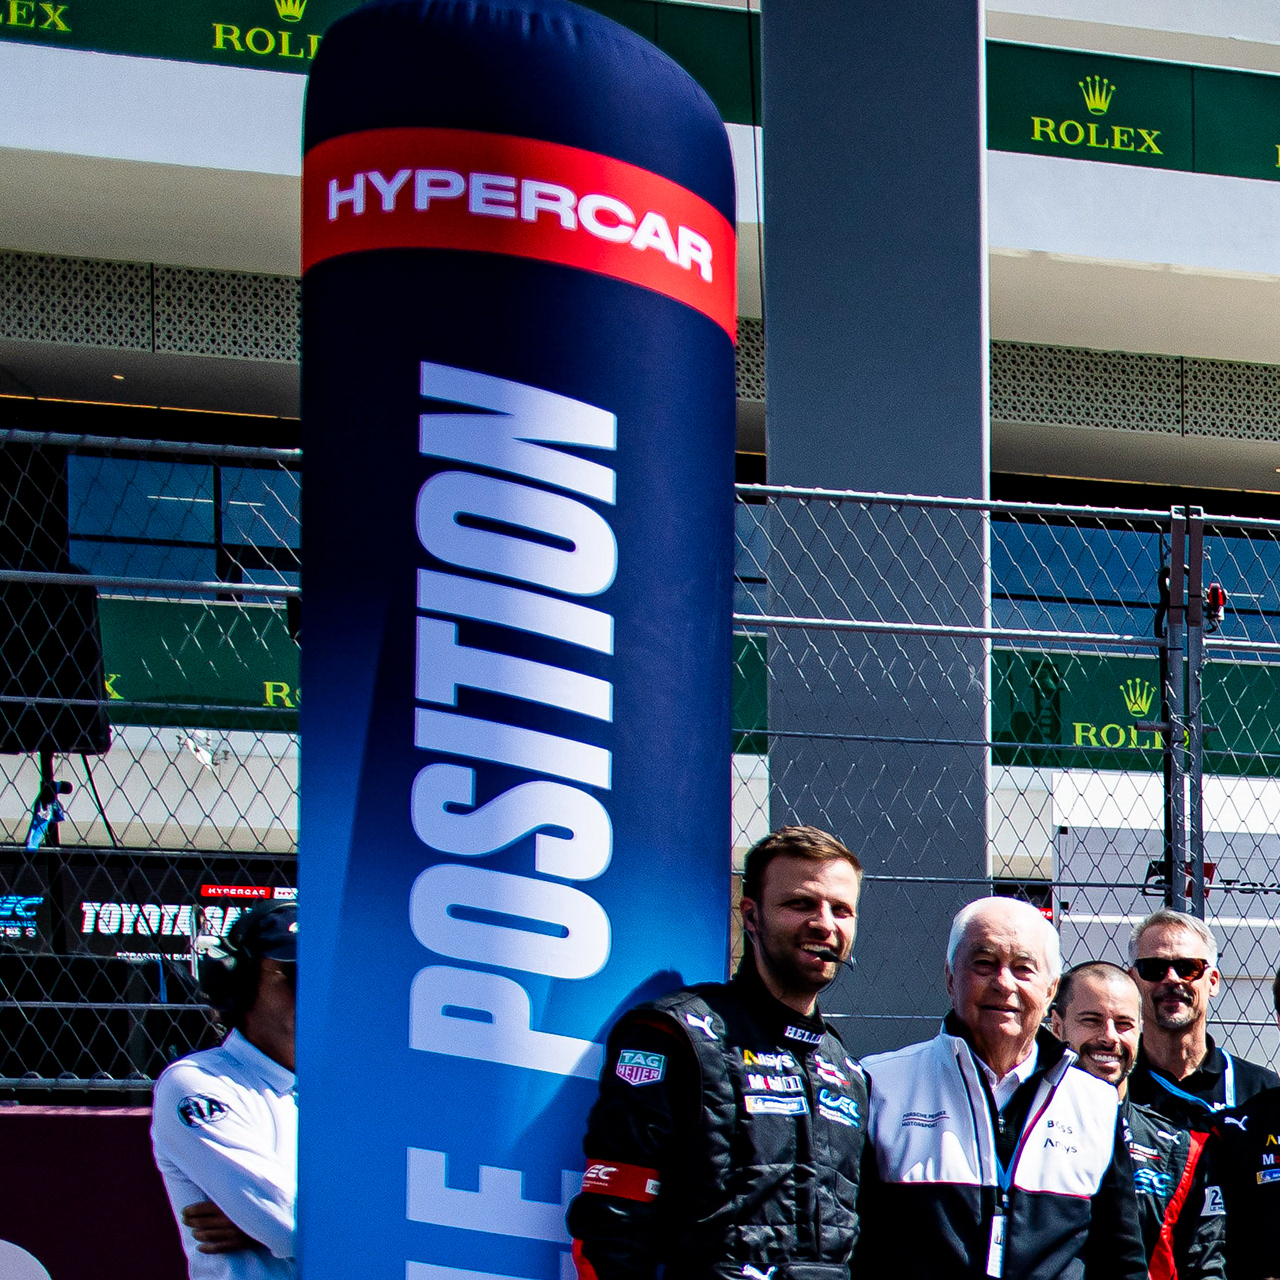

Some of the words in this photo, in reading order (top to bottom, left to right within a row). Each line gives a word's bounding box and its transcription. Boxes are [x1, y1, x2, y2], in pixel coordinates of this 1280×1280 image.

[212, 23, 320, 60] ROL
[1031, 116, 1164, 155] ROLEX
[328, 168, 715, 284] HYPERCAR
[408, 359, 619, 1081] POSITION
[81, 902, 193, 936] TOYOTA
[618, 1065, 660, 1083] HEUER
[622, 1052, 660, 1068] TAG
[743, 1049, 796, 1071] Ansys
